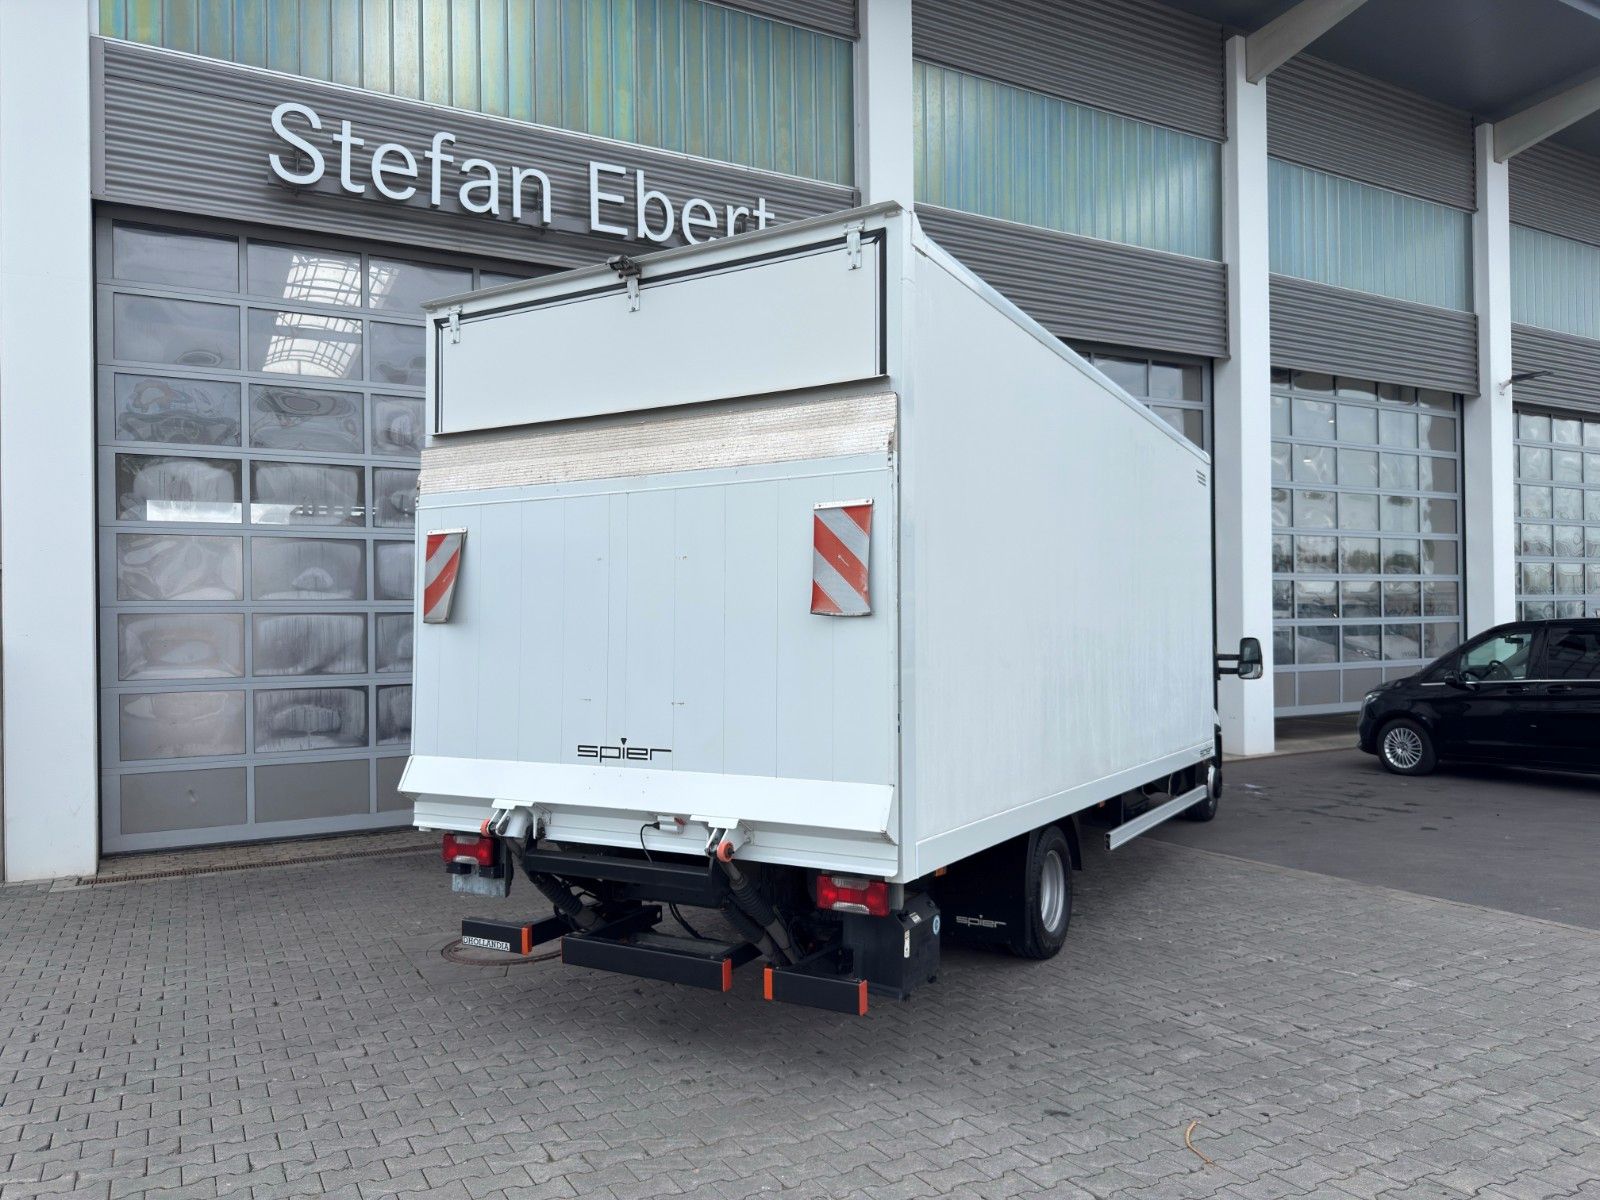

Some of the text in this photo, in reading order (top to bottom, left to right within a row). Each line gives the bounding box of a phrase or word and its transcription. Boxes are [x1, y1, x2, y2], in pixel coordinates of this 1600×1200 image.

[268, 102, 776, 245] Stefan Ebert
[577, 737, 672, 763] spier
[956, 914, 1007, 928] spier
[463, 936, 510, 950] DHOLLANDIA
